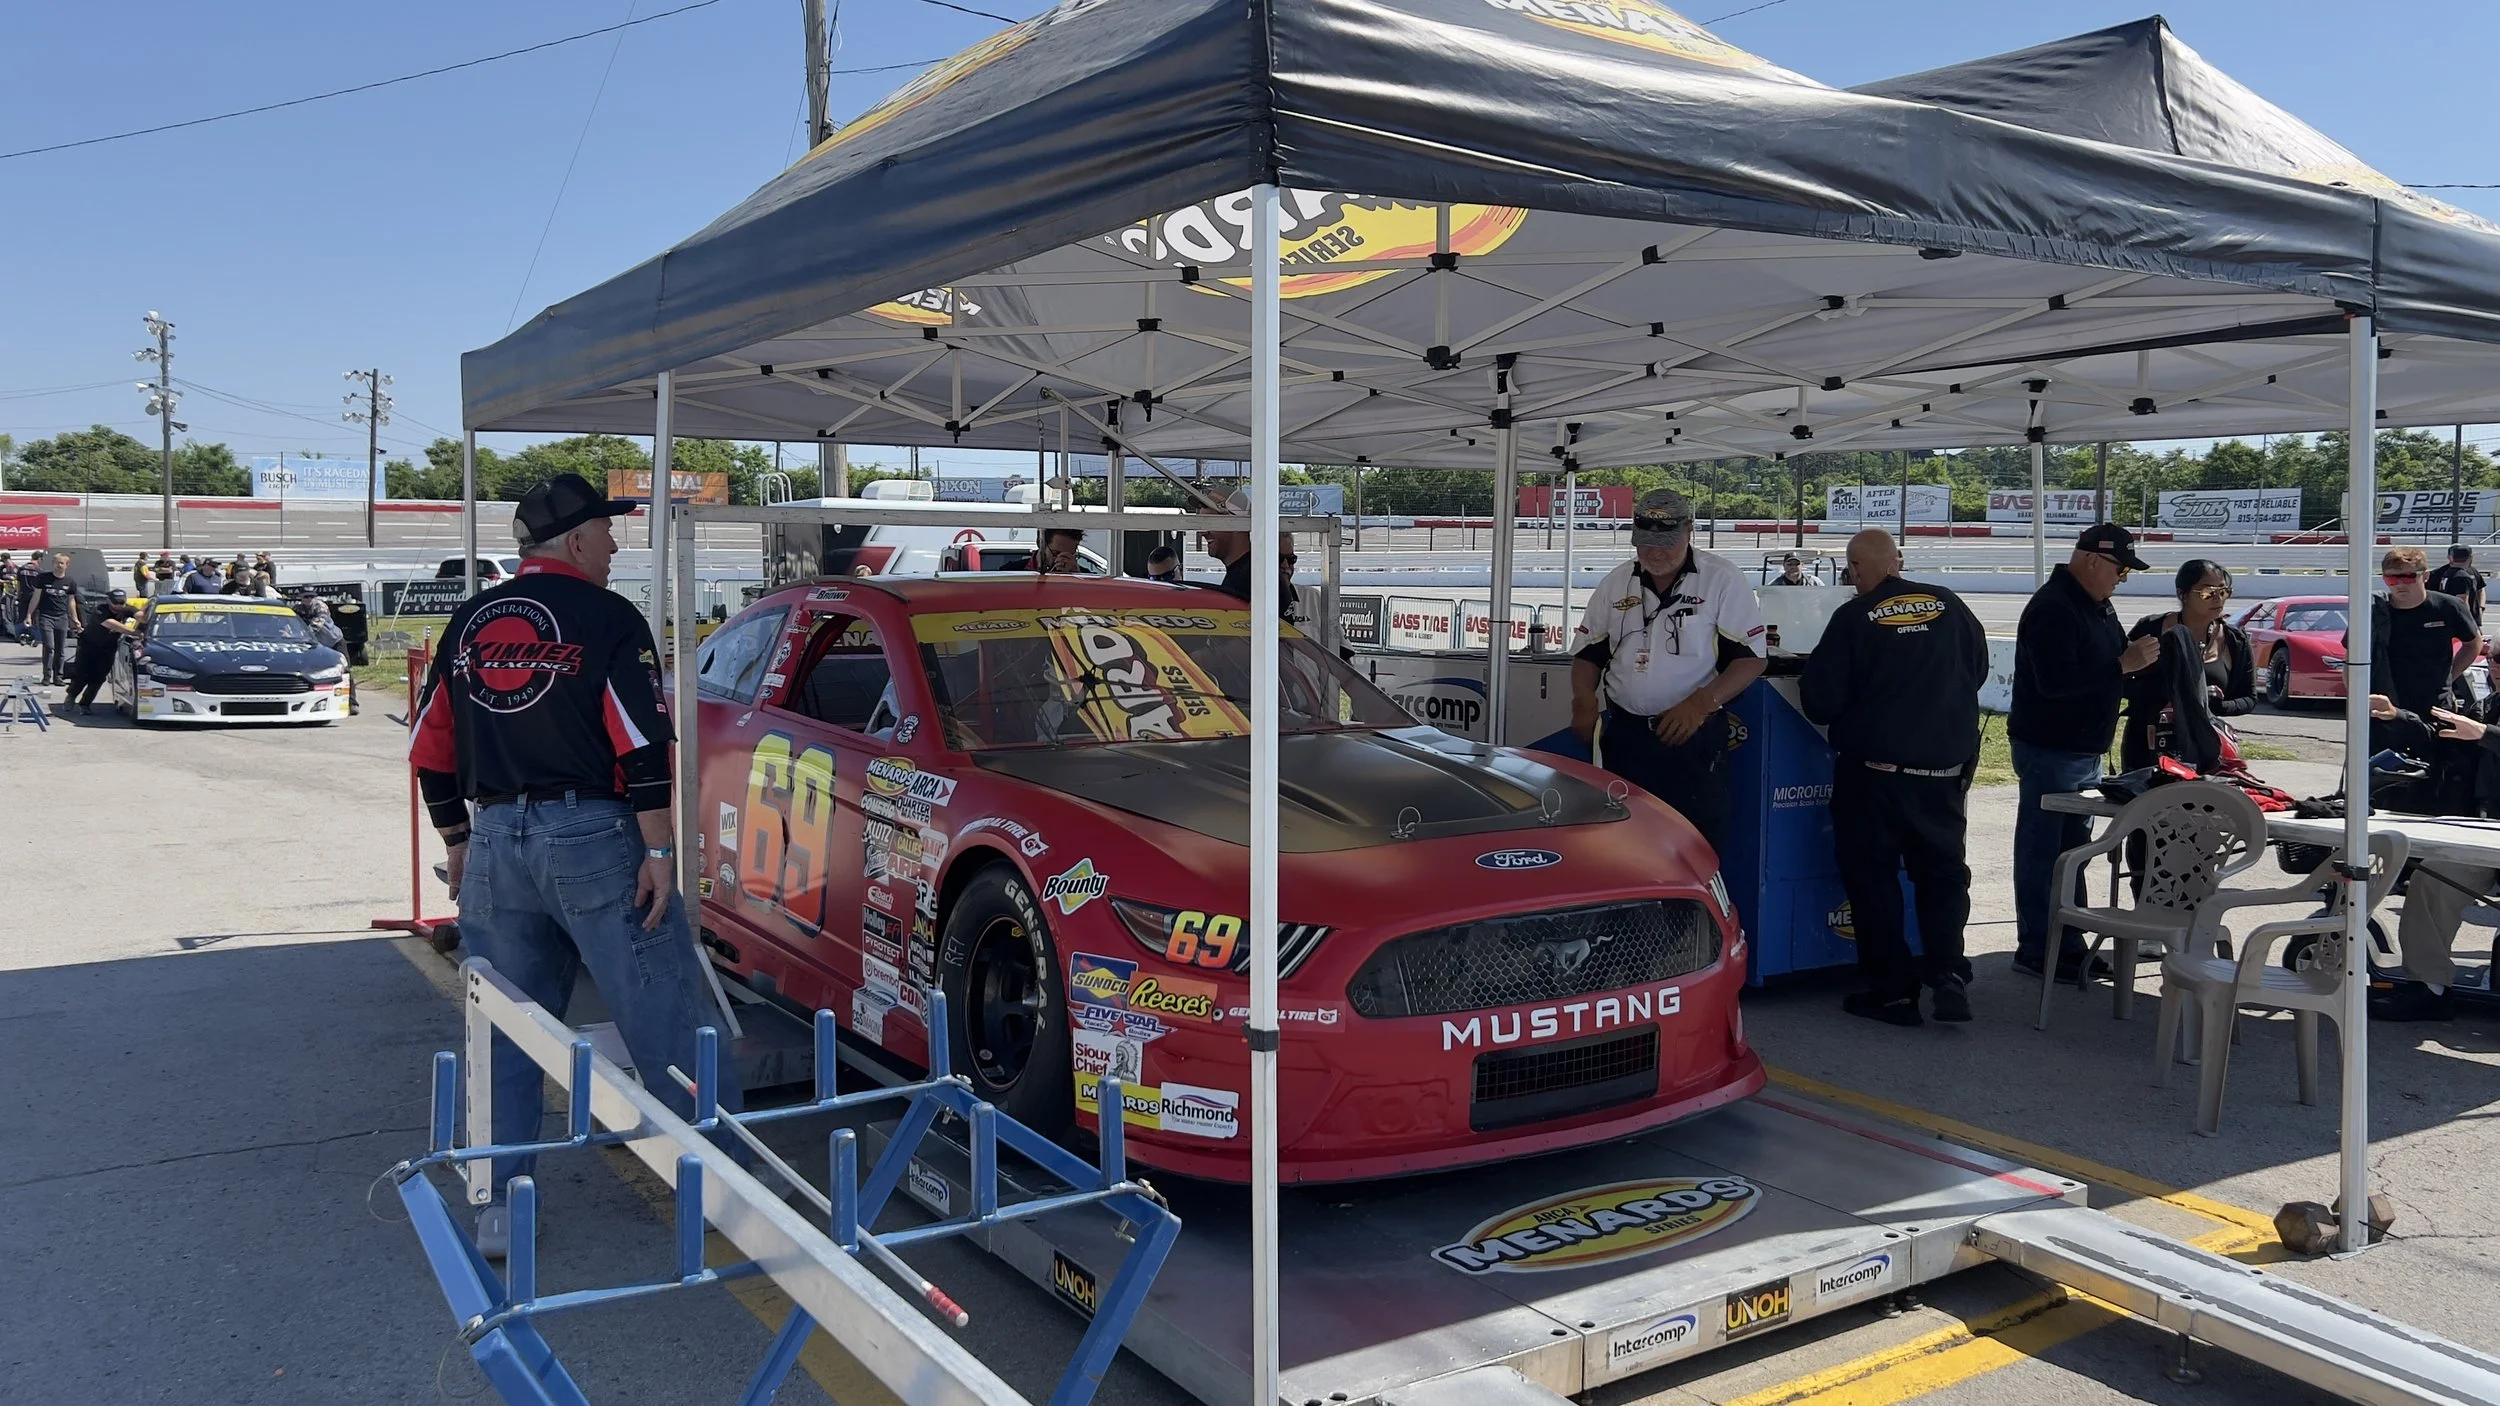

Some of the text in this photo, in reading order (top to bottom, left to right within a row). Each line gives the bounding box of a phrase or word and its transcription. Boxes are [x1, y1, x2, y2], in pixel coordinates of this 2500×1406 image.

[260, 472, 297, 483] BUSCH
[933, 480, 982, 494] DIXON
[1838, 495, 1858, 503] KID
[1866, 489, 1896, 498] AFTER
[2234, 501, 2252, 509] FAST
[2261, 499, 2297, 508] RELIABLE
[1867, 509, 1896, 518] RACES
[816, 590, 848, 600] BROWN
[477, 603, 550, 631] GENERATIONS
[1867, 600, 1947, 621] MENARDS
[953, 620, 1030, 632] MENARDS
[1393, 613, 1449, 633] BASS TIRE
[1897, 624, 1930, 634] OFFICIAL
[466, 640, 584, 663] KIMMEL
[483, 661, 571, 671] RACING
[507, 687, 535, 706] 1949
[867, 760, 915, 787] MENARDS
[909, 774, 941, 800] ARCA
[896, 797, 931, 814] QUARTER
[901, 807, 930, 824] MASTER
[720, 811, 736, 831] WIX
[866, 818, 893, 842] KLOTZ
[1001, 818, 1029, 839] TIRE
[740, 731, 836, 938] 69
[897, 836, 923, 858] CALLIES
[1493, 850, 1548, 868] Ford
[1044, 875, 1107, 899] Bounty
[864, 906, 886, 937] Holley
[864, 935, 900, 959] PYROTECT
[1165, 910, 1243, 969] 69
[1005, 878, 1048, 1037] GENERAL
[1074, 974, 1129, 994] SUNOCO
[1129, 977, 1212, 1017] Reese's
[1084, 1006, 1157, 1030] FIVE STAR
[1287, 1010, 1317, 1021] TIRE
[1442, 986, 1681, 1051] MUSTANG
[1075, 1043, 1111, 1063] Sioux
[1075, 1058, 1109, 1076] Chief
[1161, 1098, 1235, 1123] Richmond
[1445, 1180, 1752, 1270] MENARDS
[1533, 1207, 1577, 1224] ARCA
[1643, 1215, 1703, 1235] SERIES
[1055, 1259, 1095, 1308] UNOH
[1820, 1263, 1882, 1295] Intercomp
[1727, 1287, 1790, 1330] UNOH
[1614, 1325, 1686, 1358] Intercomp
